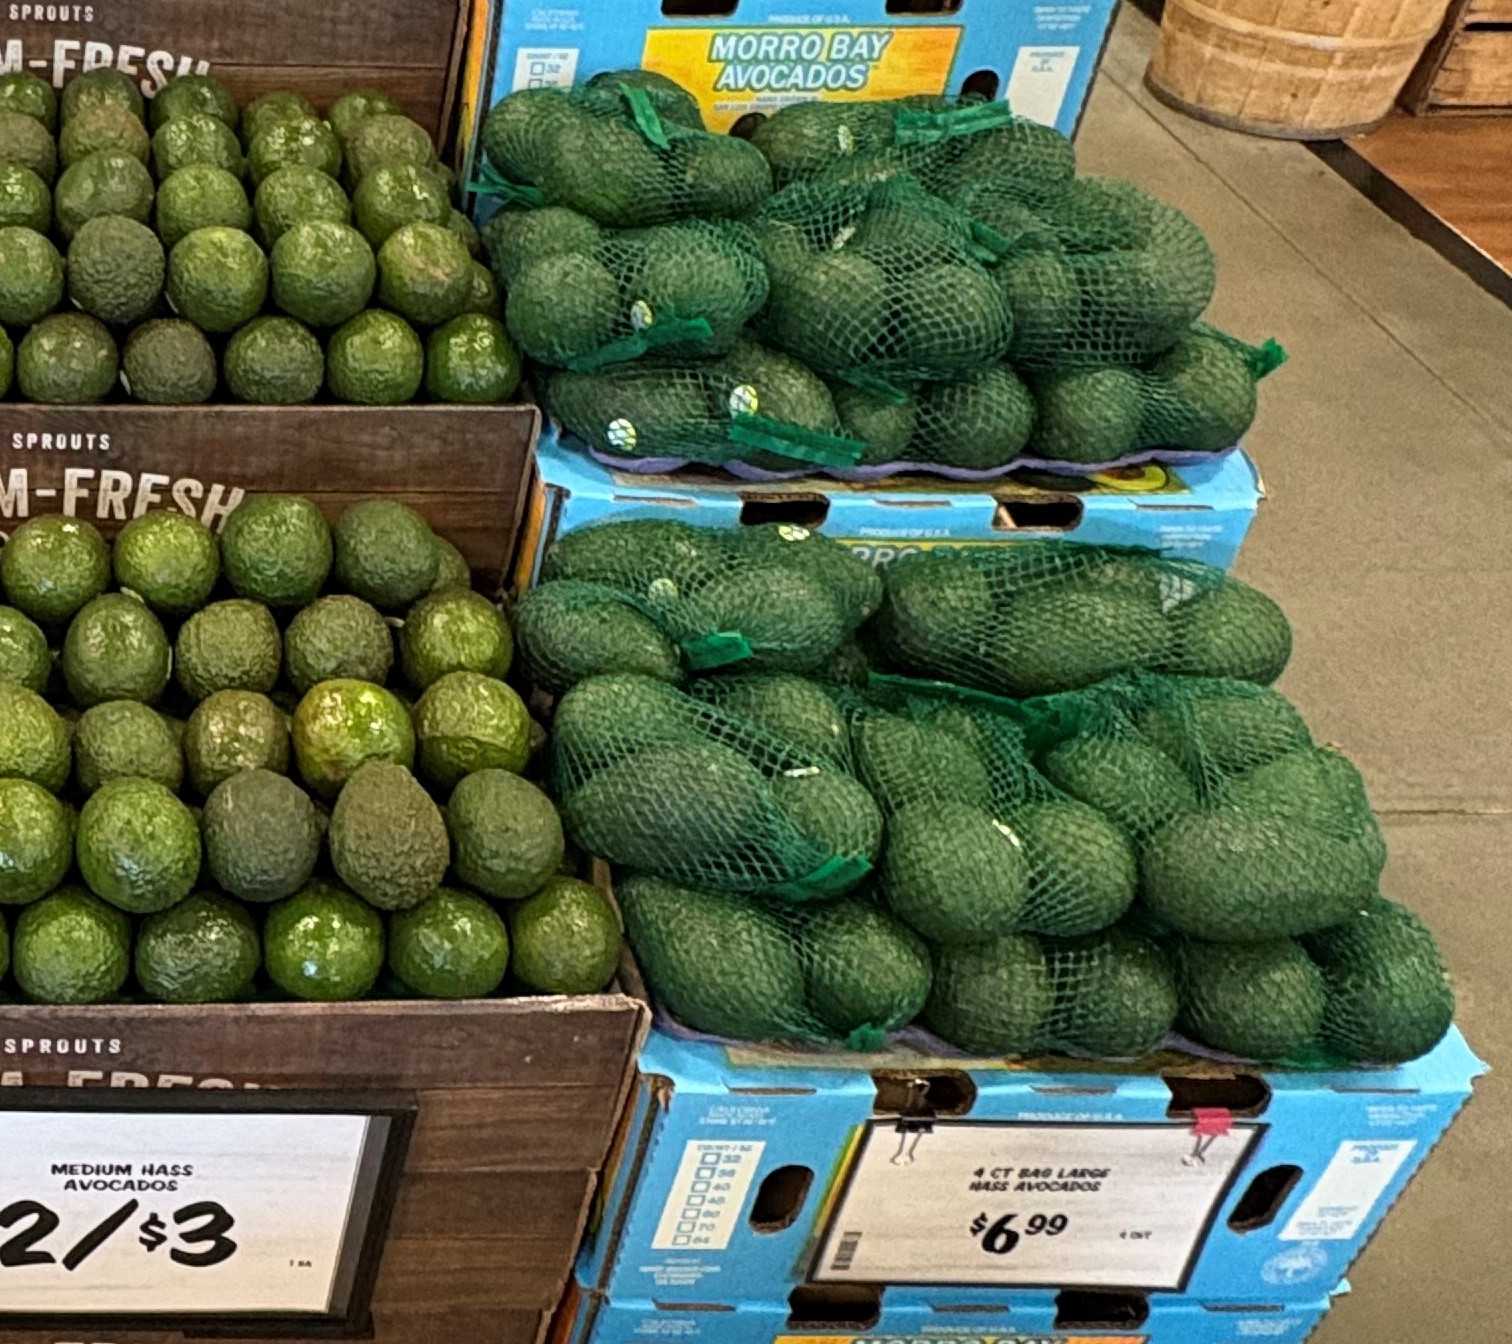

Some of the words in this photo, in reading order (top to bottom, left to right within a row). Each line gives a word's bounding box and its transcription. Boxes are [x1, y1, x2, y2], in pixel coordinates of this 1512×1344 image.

[8, 2, 95, 23] SPROUTS
[709, 33, 823, 62] MORRO
[829, 33, 892, 61] BAY
[715, 63, 868, 90] AVOCADOS
[11, 431, 112, 451] SPROUTS
[4, 1037, 122, 1055] SPROUTS
[50, 1163, 133, 1178] MEDIUM
[140, 1163, 194, 1179] HASS
[988, 1168, 1014, 1179] CT
[1017, 1167, 1054, 1179] BAG
[1056, 1167, 1112, 1179] LARGE
[63, 1178, 179, 1193] AVOCADOS
[968, 1181, 1011, 1193] HASS
[1014, 1181, 1103, 1193] AVOCADOS
